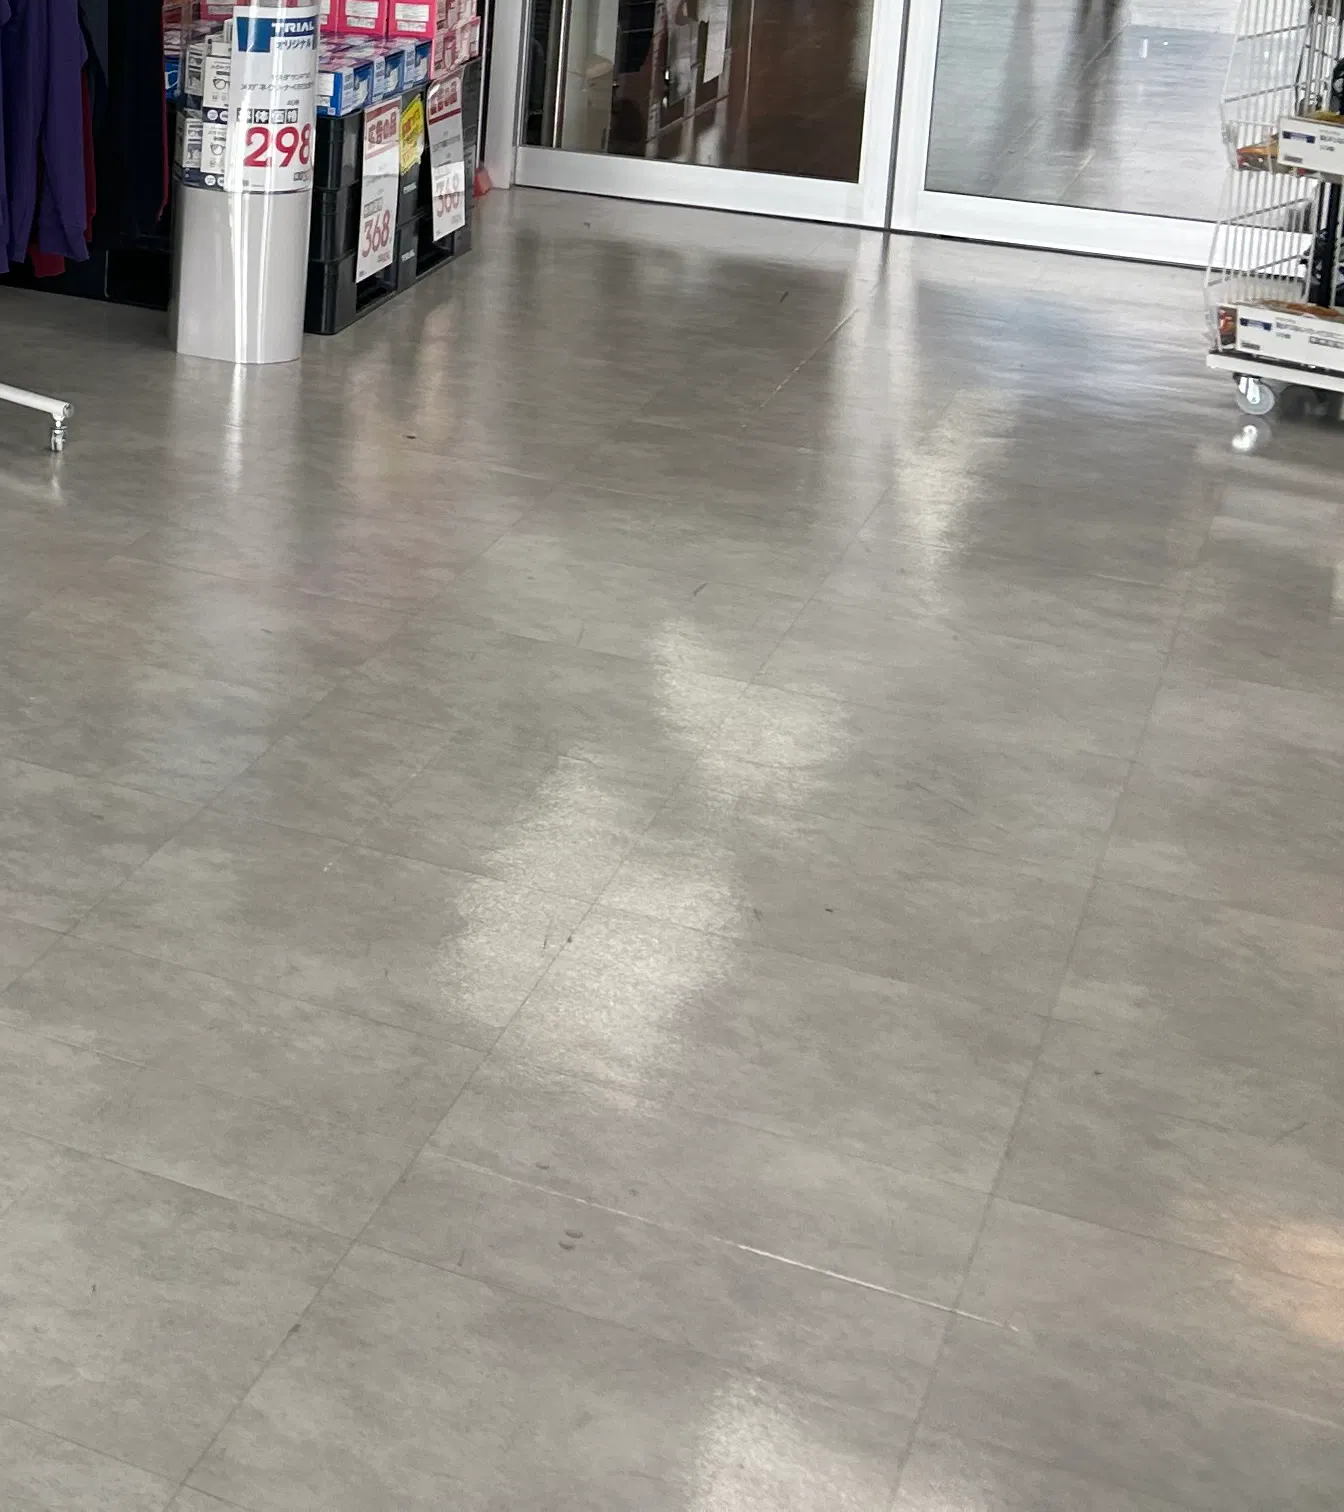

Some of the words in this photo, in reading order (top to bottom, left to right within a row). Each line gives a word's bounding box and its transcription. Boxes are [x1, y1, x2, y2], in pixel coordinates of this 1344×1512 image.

[271, 21, 315, 33] TRIAL
[244, 123, 312, 168] 298
[362, 209, 392, 258] 368
